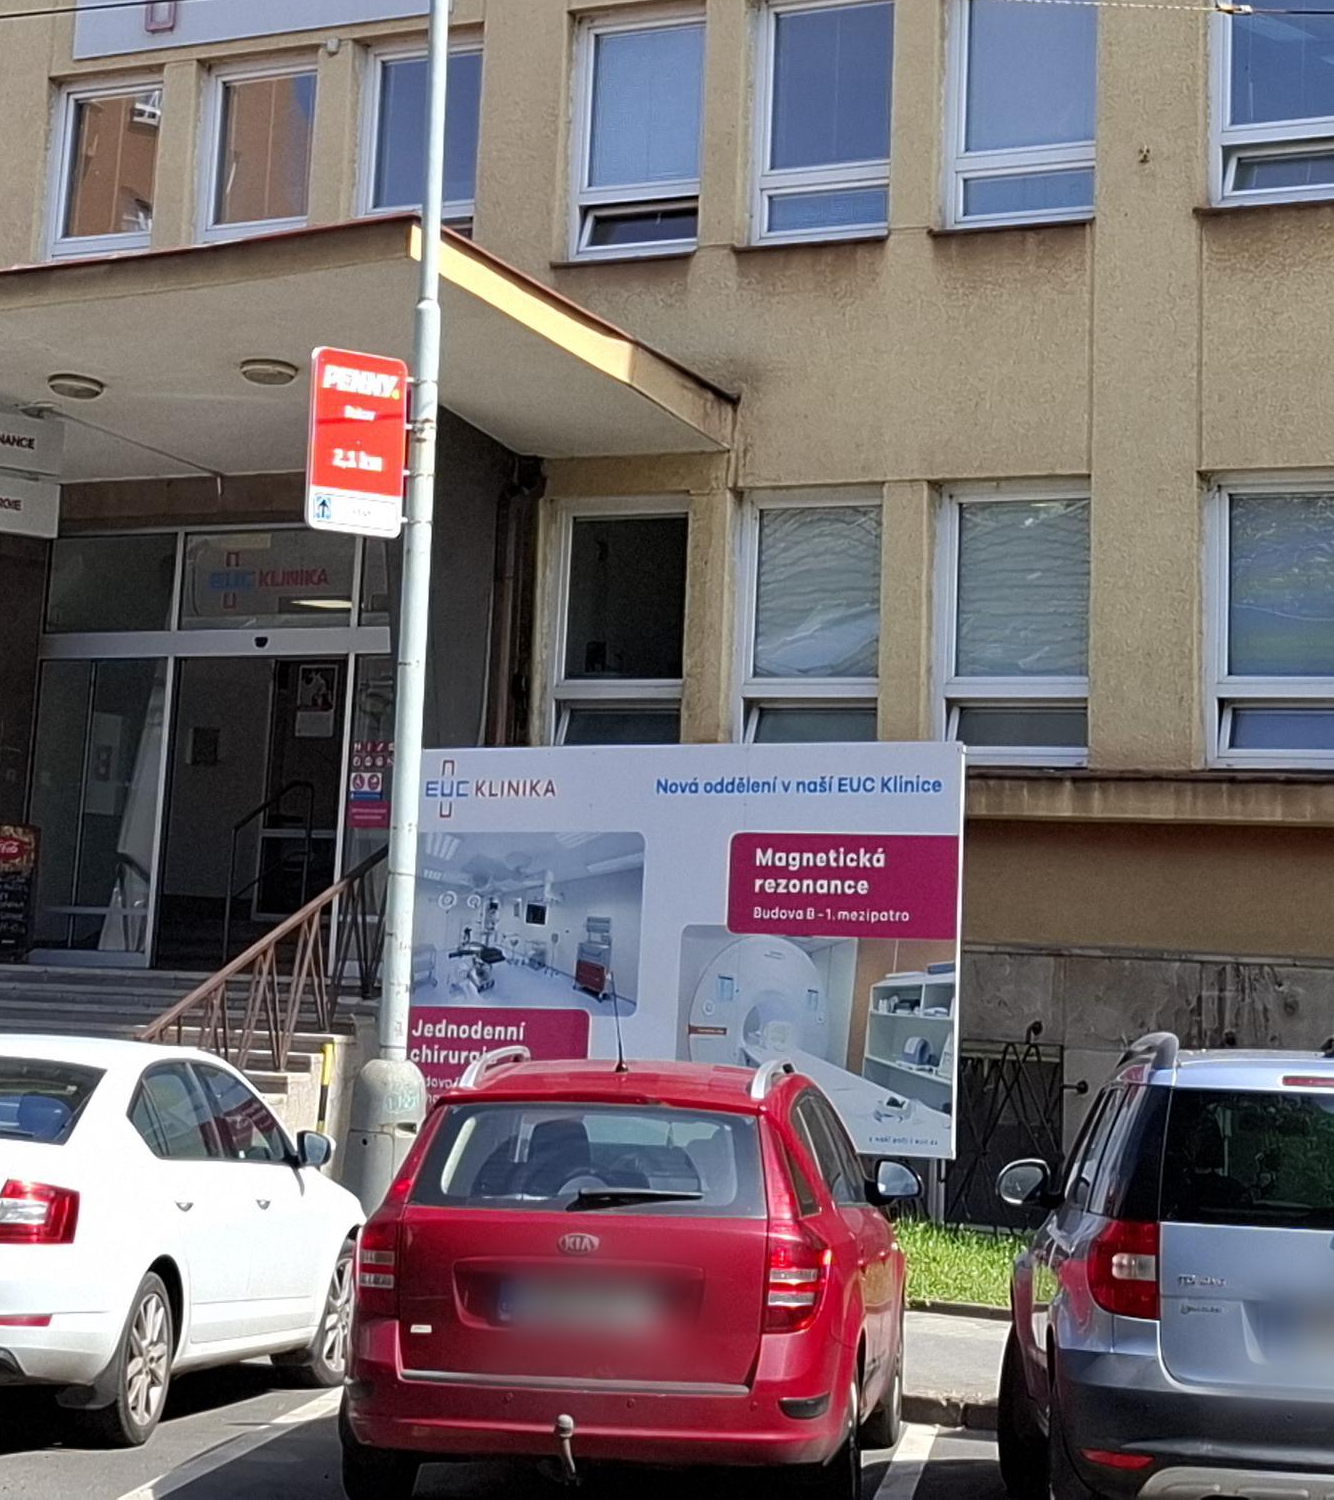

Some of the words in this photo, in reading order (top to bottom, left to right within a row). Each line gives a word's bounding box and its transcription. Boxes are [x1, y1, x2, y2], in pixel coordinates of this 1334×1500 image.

[425, 780, 469, 797] EUC
[474, 779, 556, 797] KLINIKA
[656, 777, 699, 794] Nová
[703, 776, 778, 793] oddělení
[781, 780, 791, 792] v
[796, 776, 834, 793] naší
[838, 777, 876, 793] EUC
[880, 775, 942, 793] Klinice
[755, 847, 885, 871] Magnetická
[754, 878, 869, 894] rezonance
[753, 906, 804, 920] Budova
[837, 909, 910, 924] mezipatro
[412, 1019, 527, 1041] Jednodenní
[564, 1236, 593, 1252] KIA
